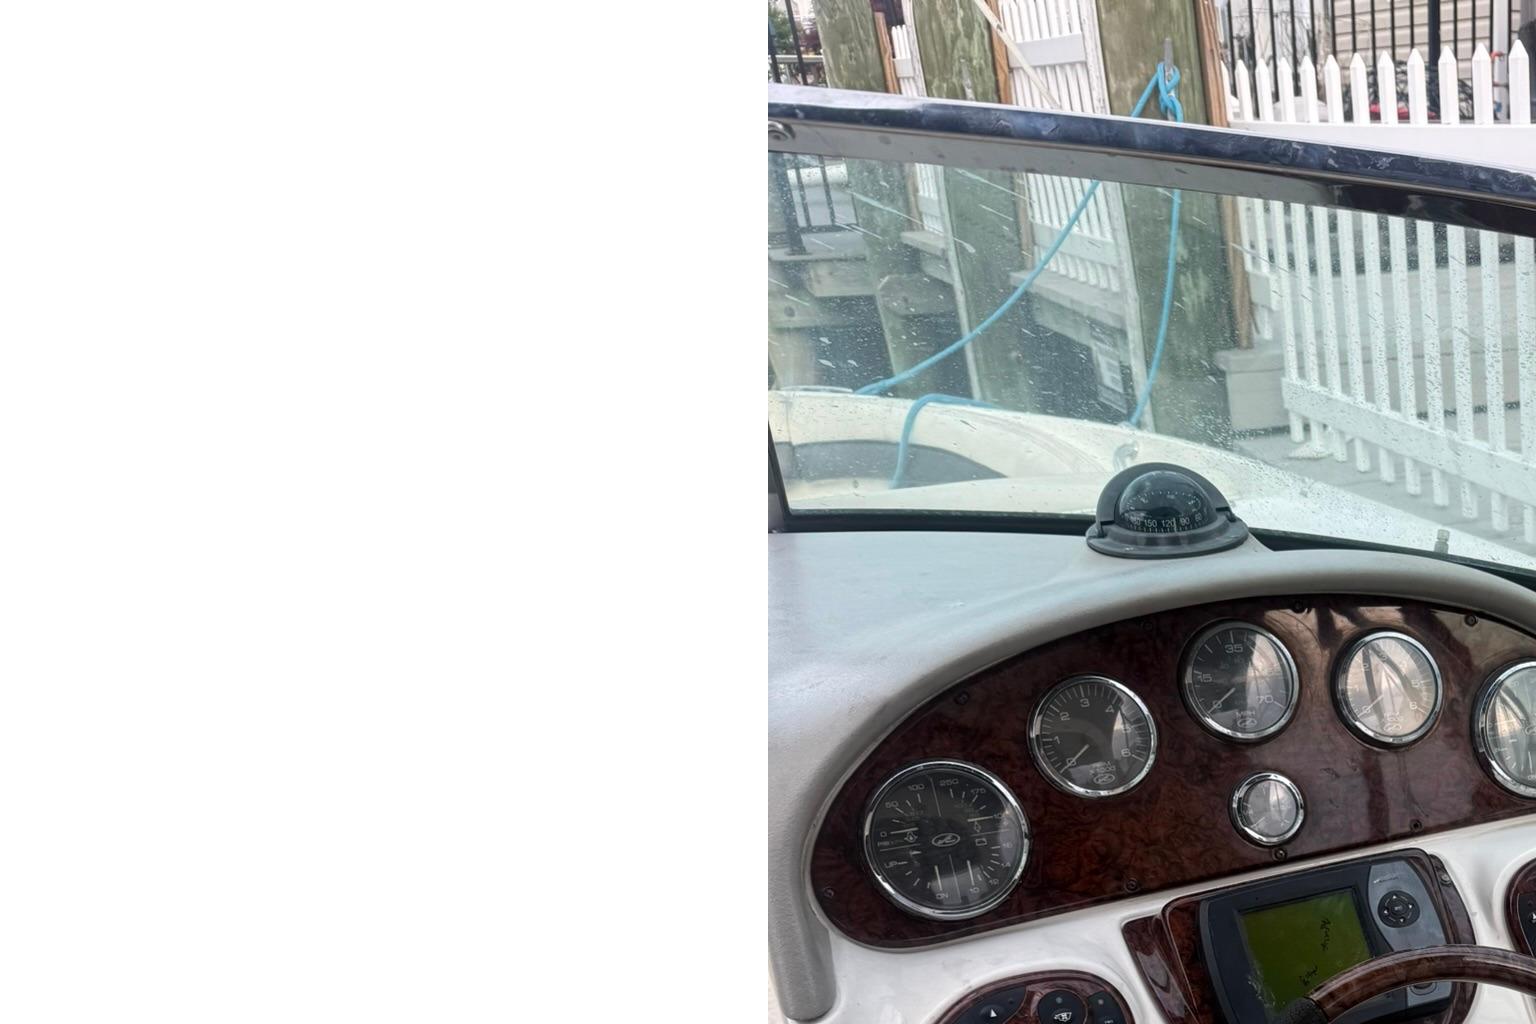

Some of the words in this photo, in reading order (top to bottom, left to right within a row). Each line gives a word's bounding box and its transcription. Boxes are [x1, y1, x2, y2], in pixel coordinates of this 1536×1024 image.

[1145, 518, 1158, 528] 150
[1162, 518, 1175, 528] 120
[1225, 644, 1243, 654] 35
[1411, 680, 1420, 688] 5
[1080, 698, 1090, 708] 3
[1256, 695, 1274, 704] 70
[1105, 704, 1115, 714] 4
[1409, 701, 1418, 710] 6
[1060, 711, 1071, 721] 2
[1121, 748, 1132, 758] 6
[907, 783, 925, 791] 100
[939, 778, 960, 787] 250
[885, 800, 899, 809] 50
